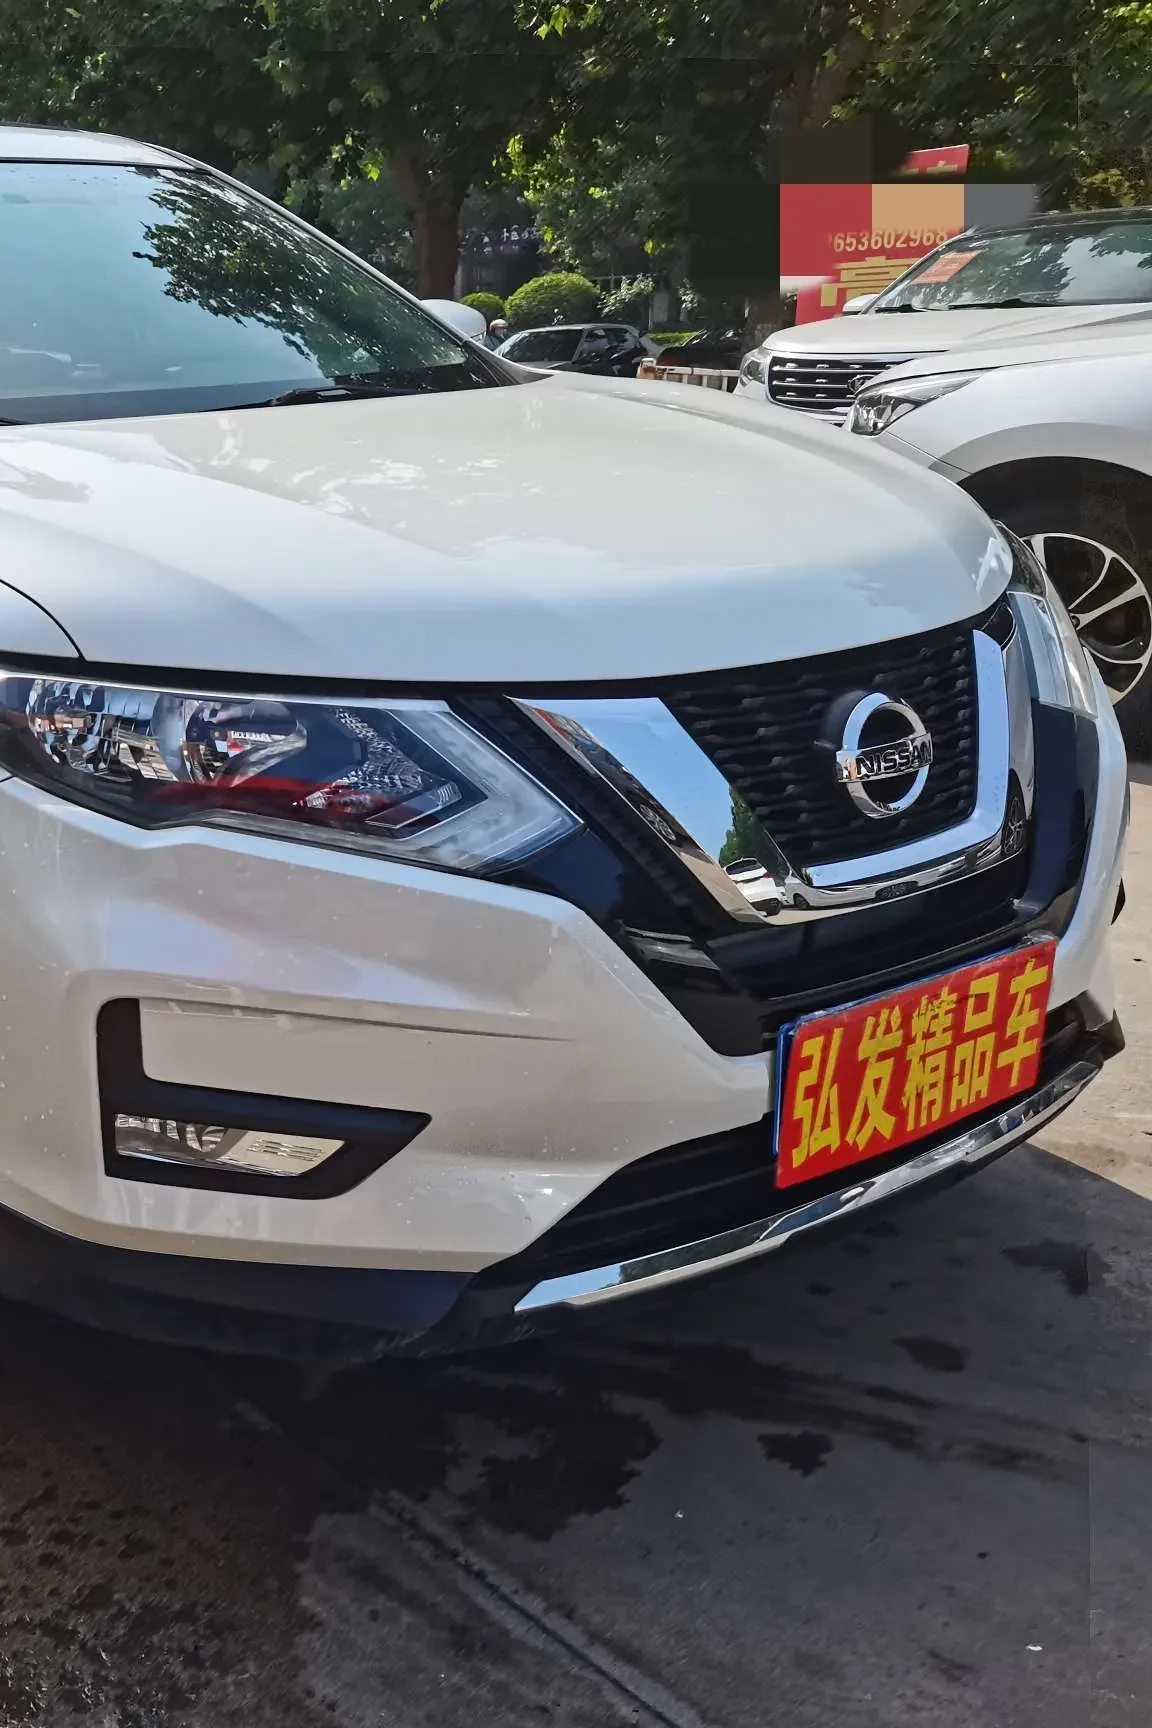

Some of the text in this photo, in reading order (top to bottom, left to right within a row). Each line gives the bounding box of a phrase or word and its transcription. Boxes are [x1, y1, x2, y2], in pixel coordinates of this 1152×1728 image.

[855, 741, 931, 777] NISSAN
[792, 957, 1049, 1168] 弘发精品车
